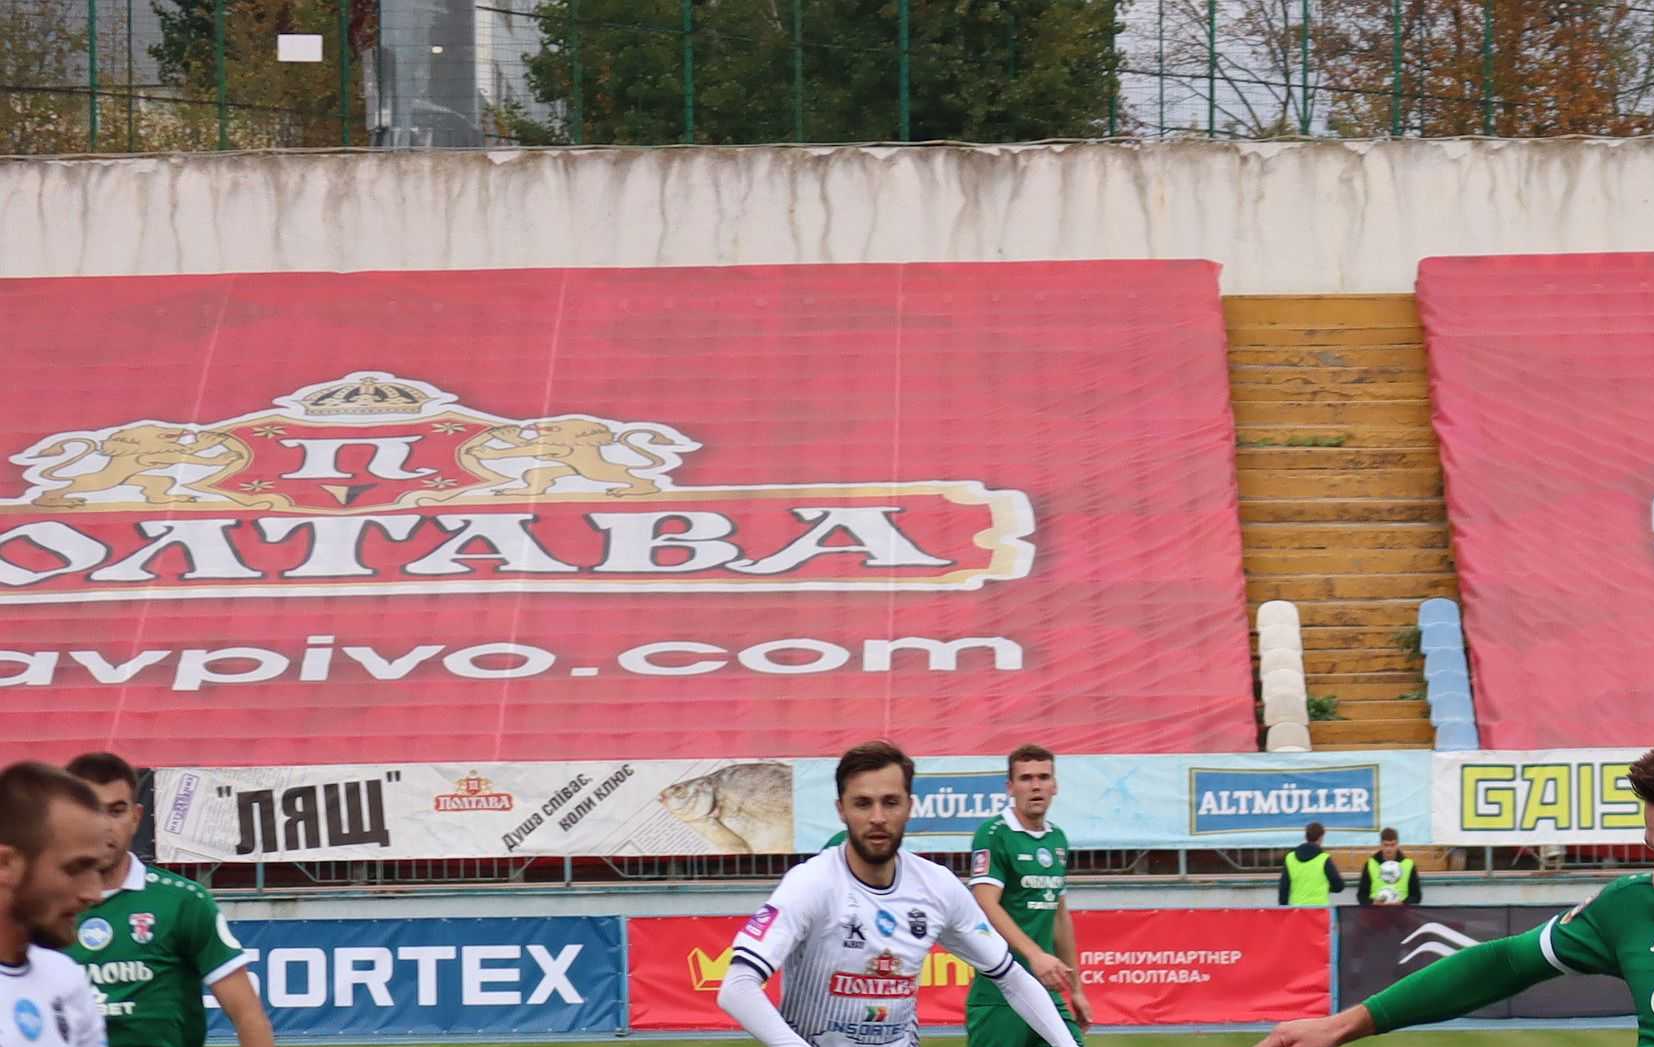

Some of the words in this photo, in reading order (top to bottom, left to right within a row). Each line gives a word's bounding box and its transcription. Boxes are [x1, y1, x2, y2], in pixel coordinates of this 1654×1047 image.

[0, 506, 955, 587] ОЛТАВА
[910, 787, 1011, 818] MÜLLE
[1198, 783, 1370, 815] ALTMÜLLER
[1460, 763, 1646, 831] GAIS
[558, 797, 595, 832] коли
[502, 812, 544, 853] Душа
[1080, 950, 1242, 965] ПРЕМІУМПАРТНЕР
[1080, 970, 1104, 984] СК
[1108, 969, 1210, 984] «ПОЛТАВА»
